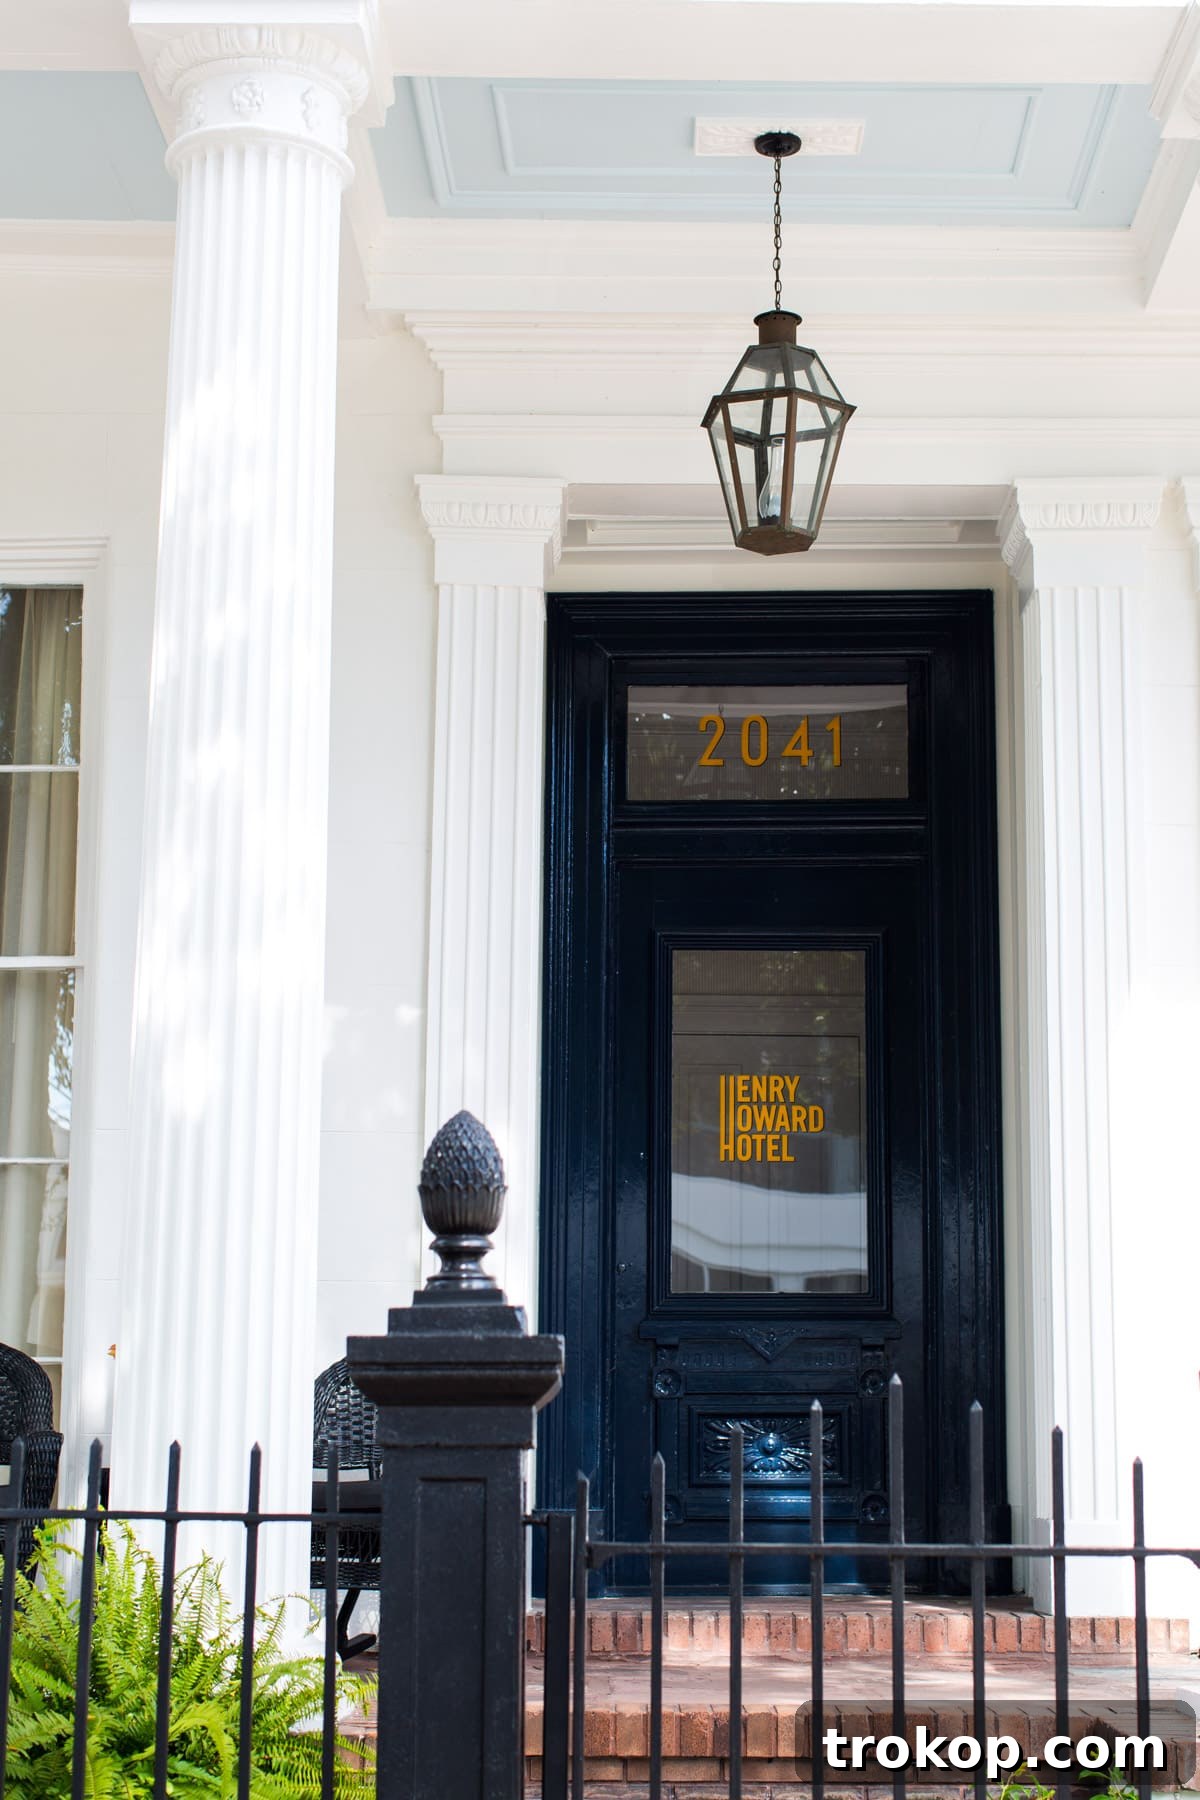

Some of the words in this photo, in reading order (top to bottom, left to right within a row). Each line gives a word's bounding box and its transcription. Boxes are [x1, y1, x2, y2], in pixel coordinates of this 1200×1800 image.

[698, 714, 842, 767] 2041
[719, 1074, 800, 1103] HENRY
[719, 1133, 796, 1162] HOTEL
